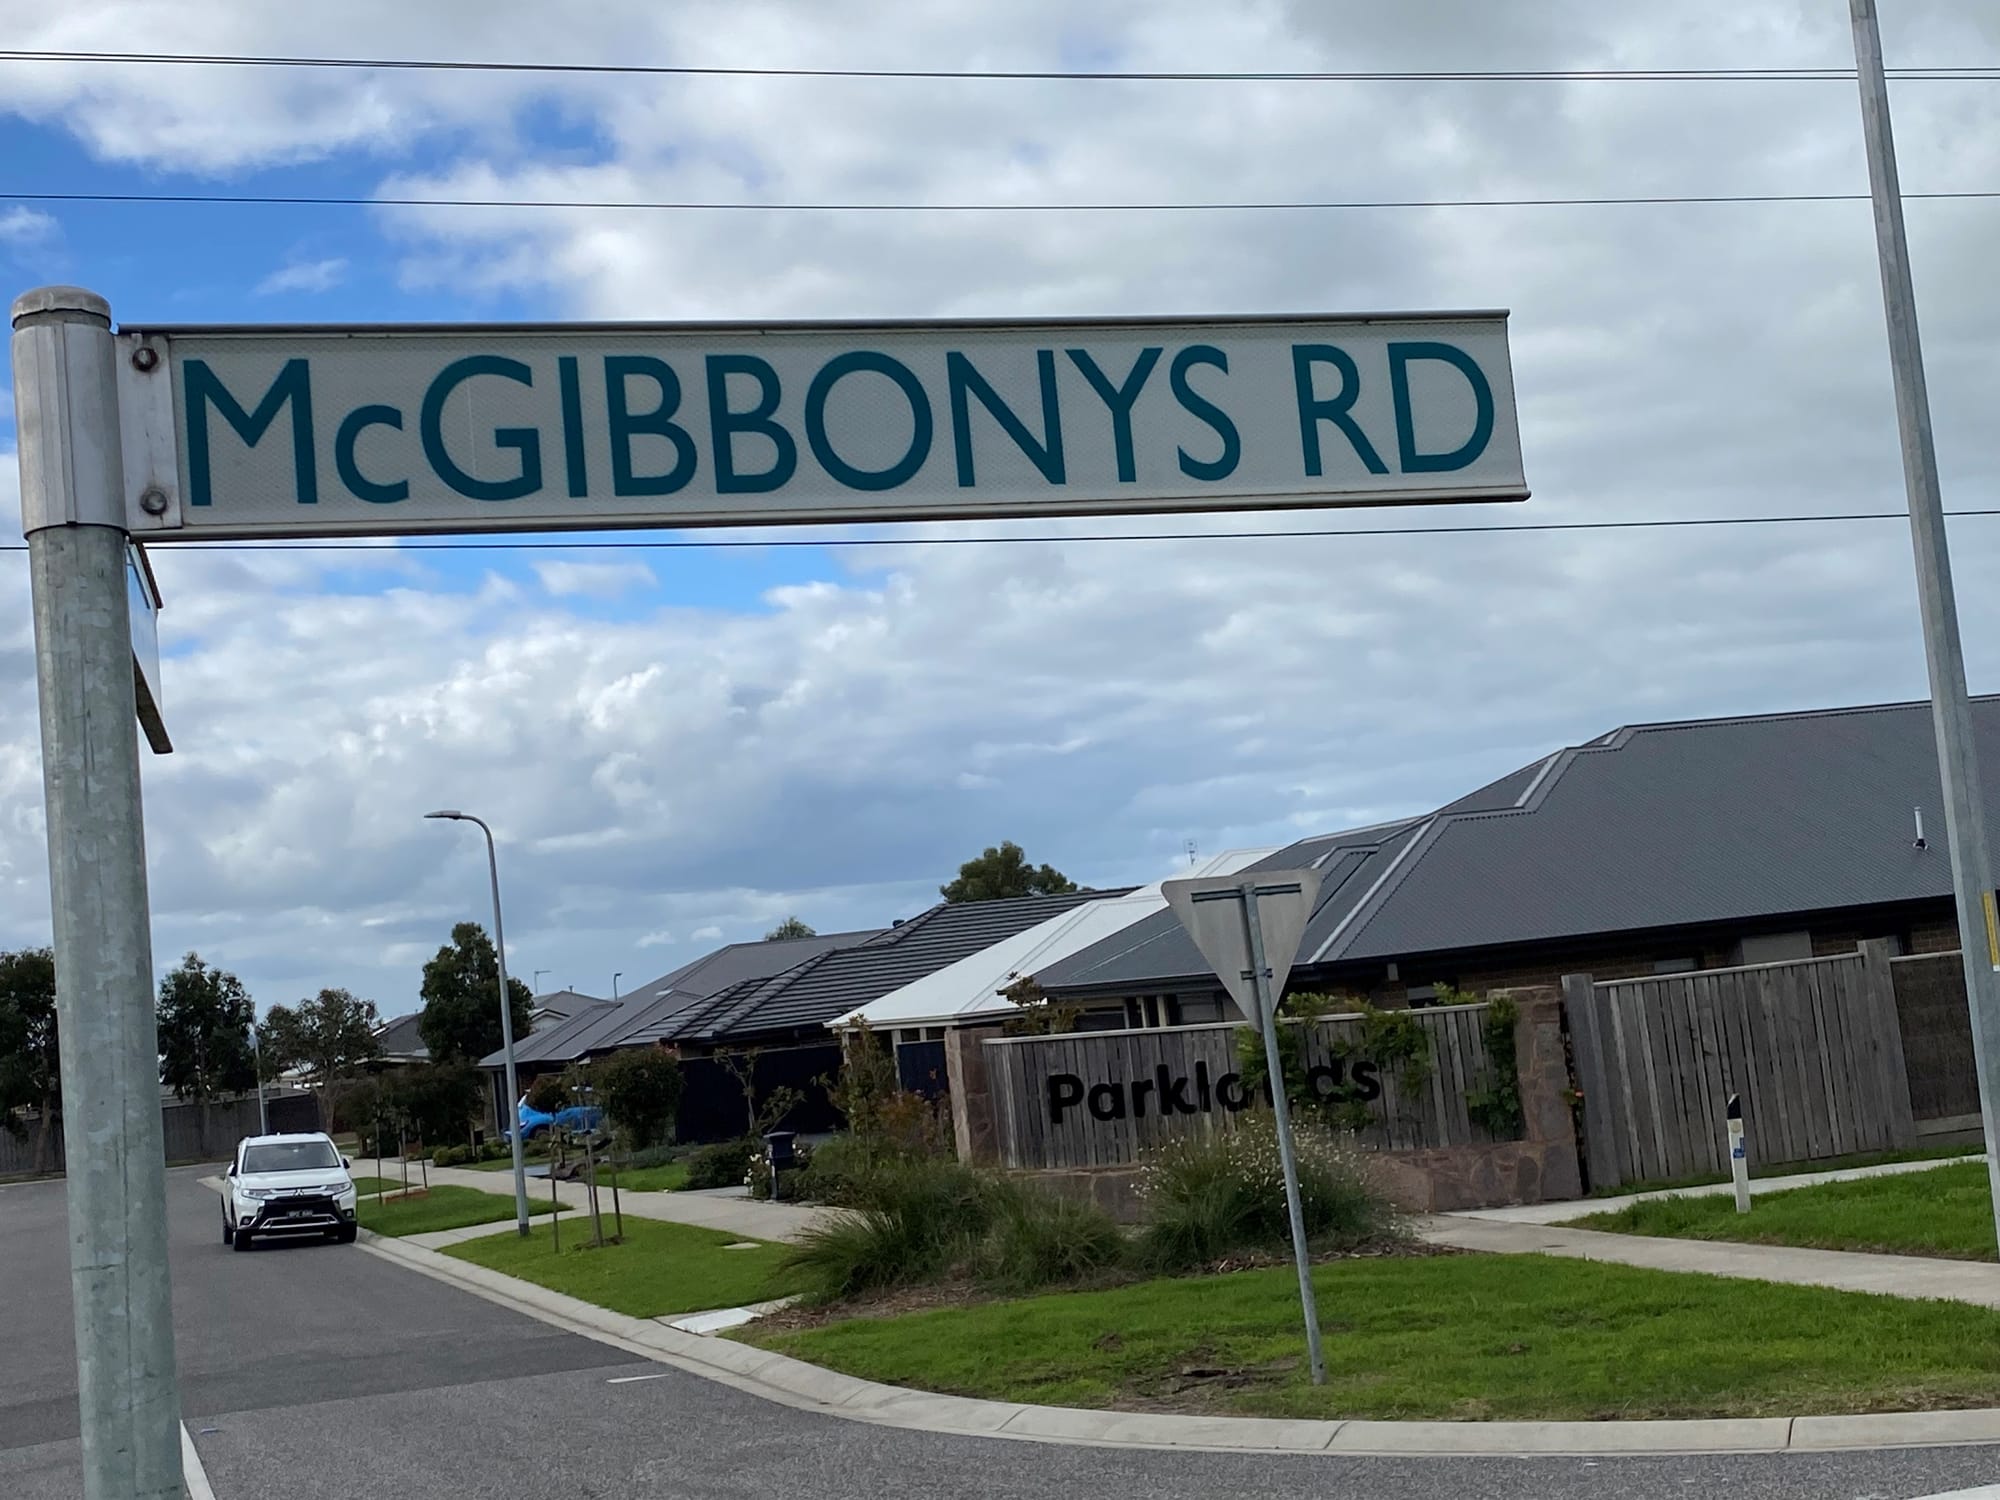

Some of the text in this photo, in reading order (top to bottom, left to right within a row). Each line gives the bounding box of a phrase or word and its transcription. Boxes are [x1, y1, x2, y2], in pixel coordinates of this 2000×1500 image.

[183, 341, 1494, 506] McGIBBONYS RD
[1048, 1060, 1381, 1124] Parklads
